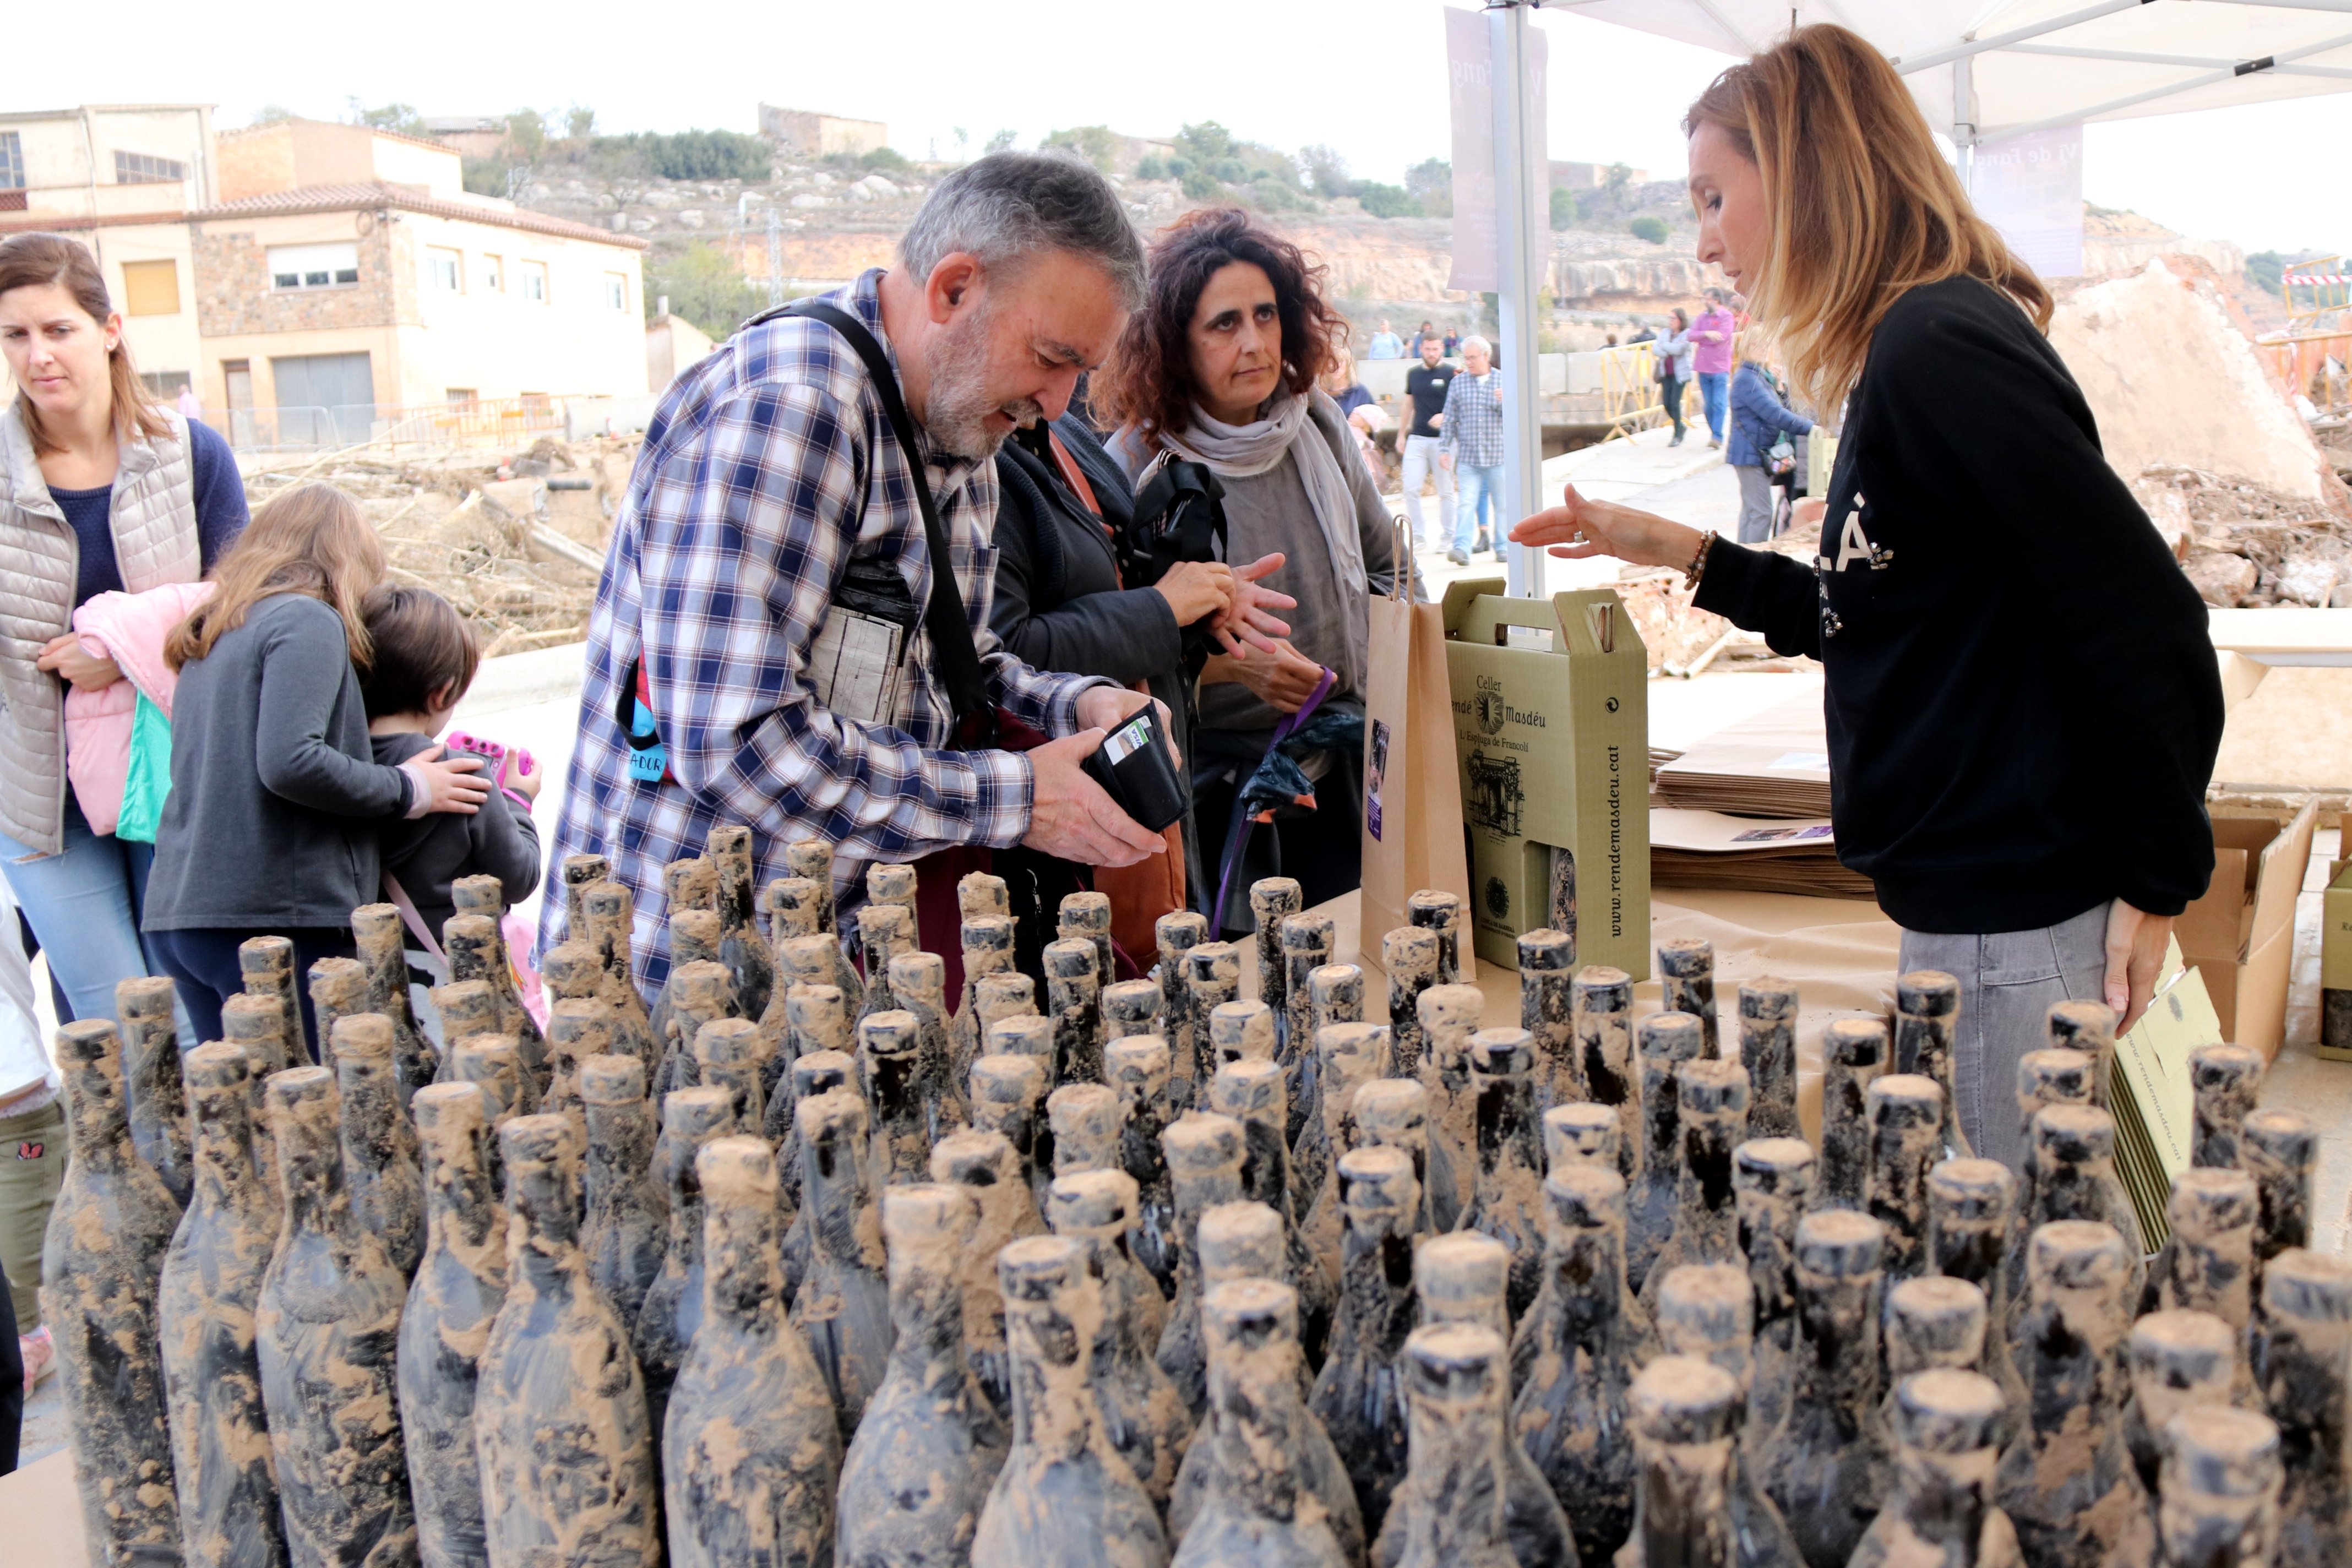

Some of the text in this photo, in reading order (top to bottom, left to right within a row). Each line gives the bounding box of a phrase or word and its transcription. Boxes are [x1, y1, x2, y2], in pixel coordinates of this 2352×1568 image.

[1477, 674, 1502, 692] Celler
[1505, 705, 1546, 728] Masdéu
[1131, 728, 1142, 747] VISA
[1460, 729, 1529, 753] L'Espluga de Francolí
[630, 753, 663, 772] ADOR
[1608, 744, 1621, 938] www.rendemasdeu.cat
